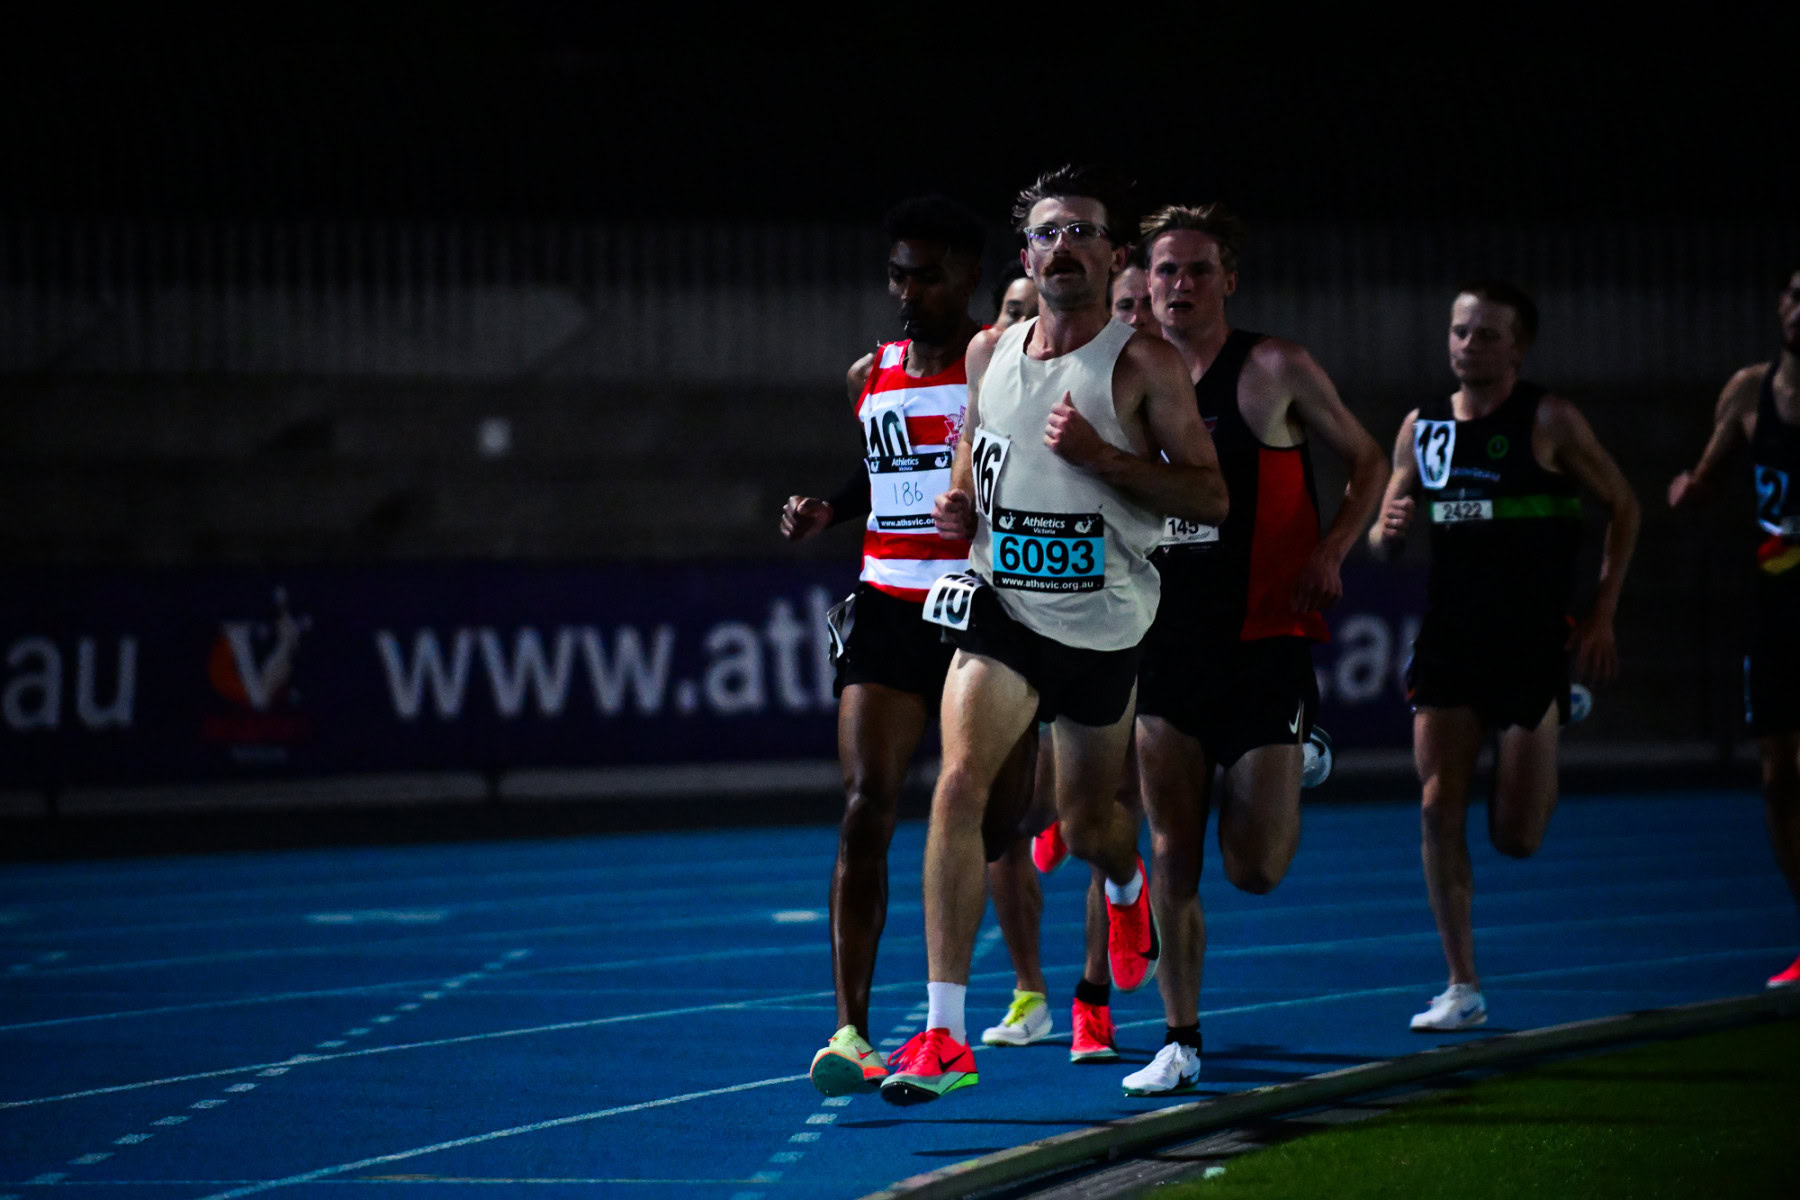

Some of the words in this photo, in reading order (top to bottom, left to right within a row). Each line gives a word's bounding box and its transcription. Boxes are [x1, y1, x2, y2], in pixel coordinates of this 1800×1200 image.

[1419, 423, 1449, 481] 13
[891, 457, 919, 467] Athletics
[973, 437, 1002, 515] 16
[893, 481, 923, 506] 186
[1443, 503, 1482, 520] 2422
[880, 517, 936, 528] www.athsvic.or
[1022, 516, 1066, 529] Athletics
[1000, 536, 1095, 574] 6093
[1001, 576, 1094, 590] www.athsvic.org.au
